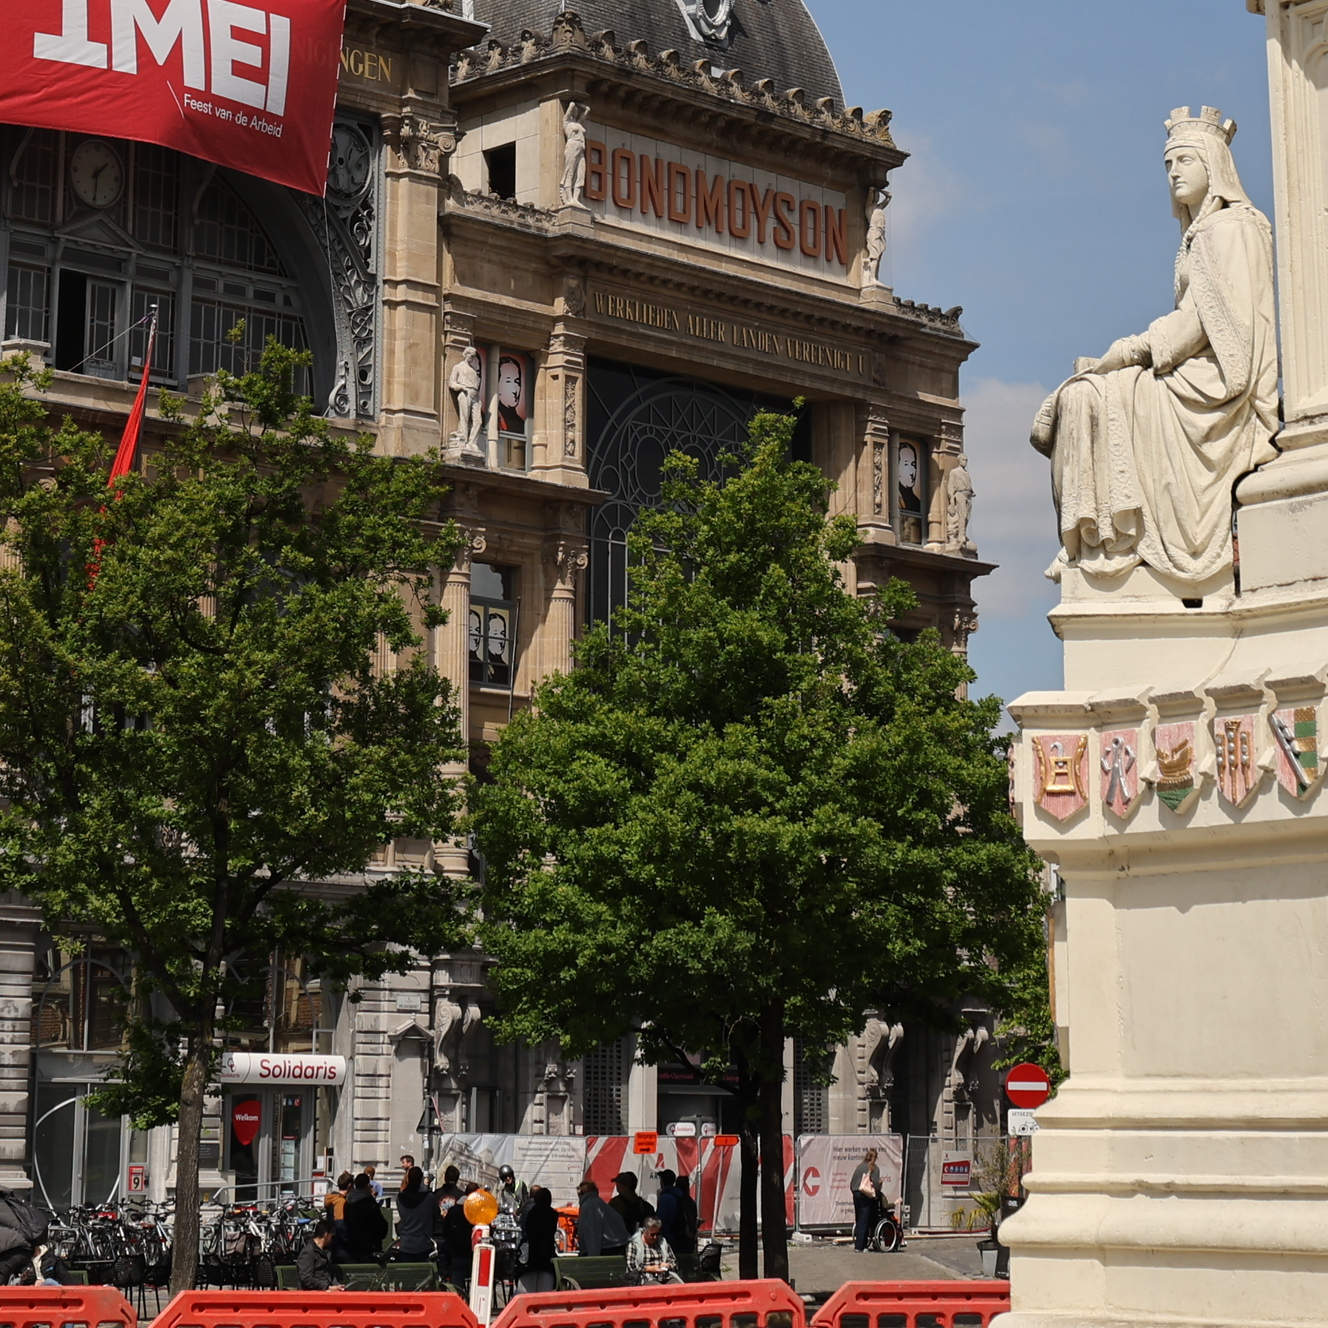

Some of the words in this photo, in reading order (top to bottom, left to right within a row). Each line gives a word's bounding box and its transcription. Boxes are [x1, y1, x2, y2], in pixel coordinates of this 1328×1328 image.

[340, 47, 392, 82] NGEN
[184, 93, 212, 115] Feest
[215, 106, 232, 121] van
[235, 112, 248, 126] de
[250, 115, 283, 138] Arbeid
[594, 291, 679, 332] WERKLIEDEN
[687, 314, 726, 344] ALLER
[732, 324, 781, 354] LANDEN
[786, 338, 853, 372] VEREENIGT
[259, 1059, 337, 1080] Solidaris
[133, 1177, 140, 1189] 9
